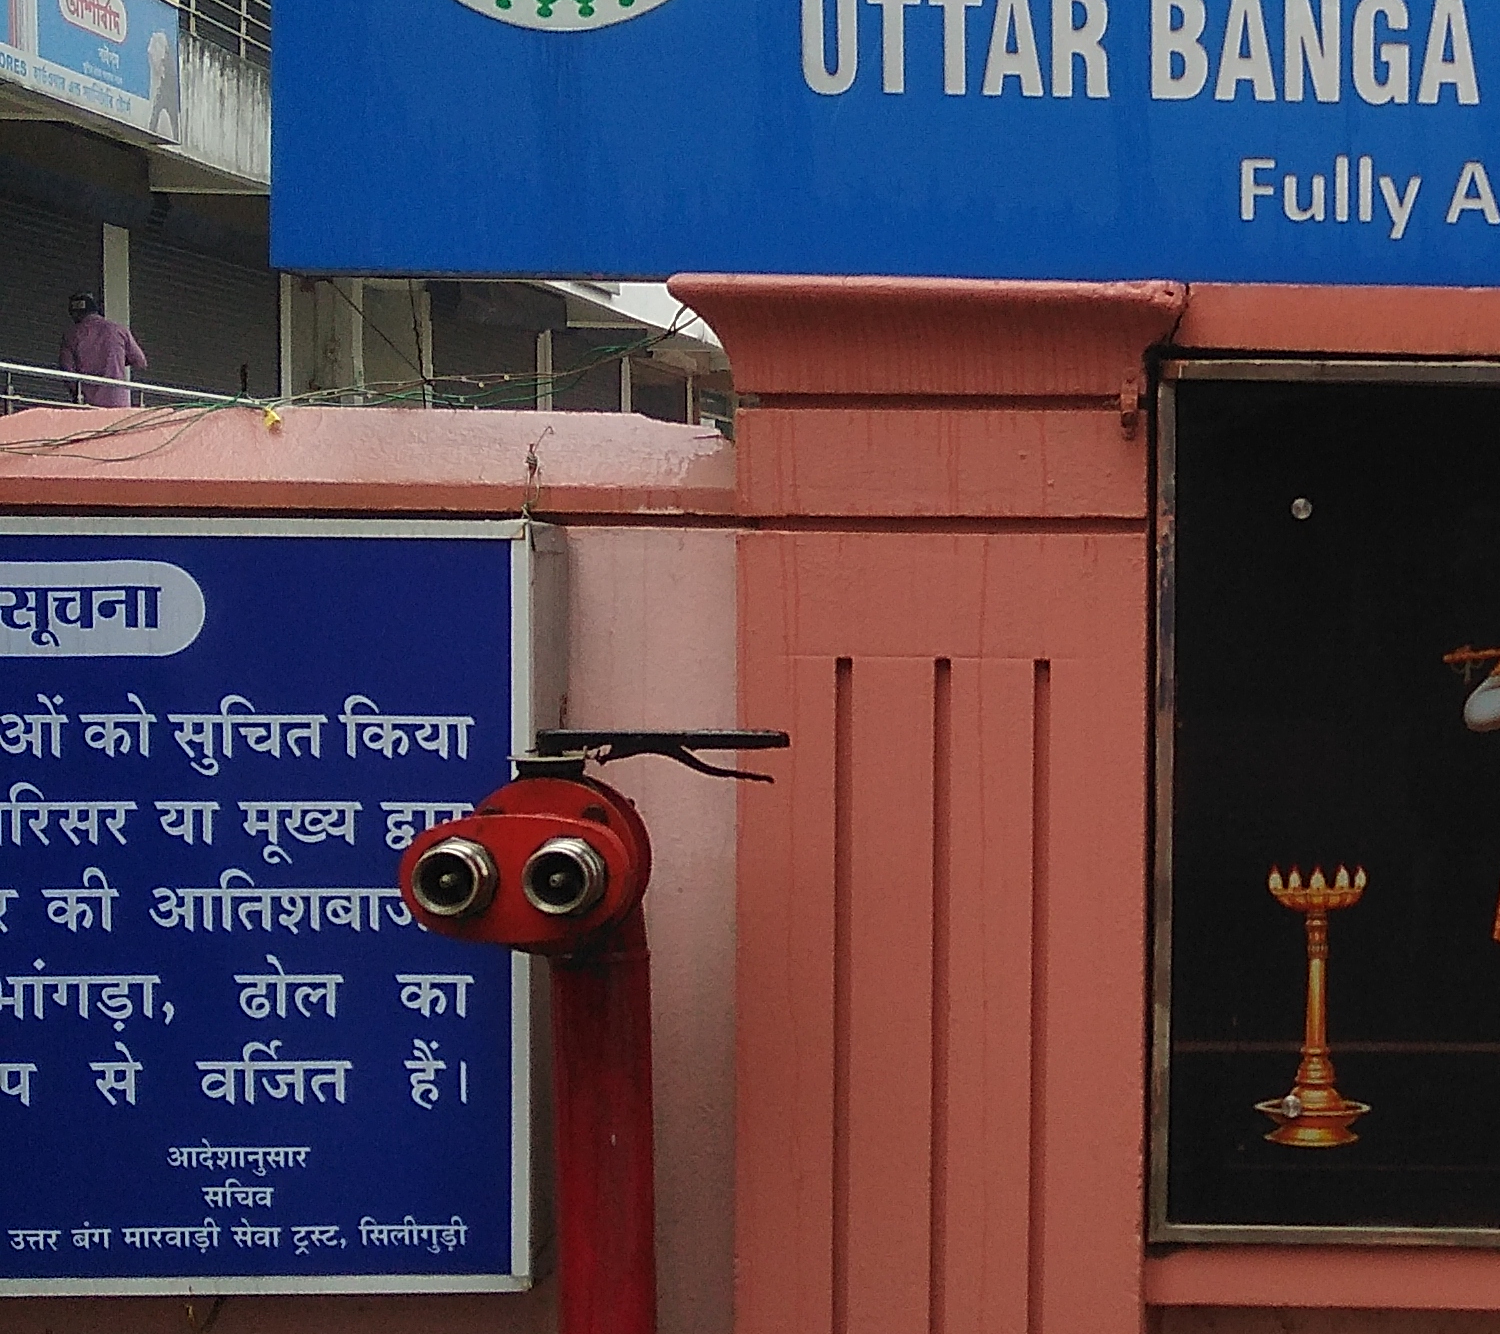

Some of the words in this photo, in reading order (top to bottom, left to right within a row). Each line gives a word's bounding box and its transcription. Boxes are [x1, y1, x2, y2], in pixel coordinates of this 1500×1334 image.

[1239, 155, 1422, 239] Fully
[0, 585, 162, 647] सूचना
[79, 693, 157, 759] को
[168, 695, 328, 775] सुचित
[339, 696, 475, 760] किया
[0, 782, 138, 847] रिसर
[154, 801, 220, 846] या
[42, 867, 119, 933] की
[234, 954, 343, 1019] ढोल
[396, 974, 475, 1019] का
[90, 1040, 143, 1106] से
[196, 1040, 353, 1106] वर्जित
[167, 1138, 311, 1177] आदेशानुसार
[202, 1178, 275, 1208] सचिव
[8, 1229, 62, 1252] उत्तर
[71, 1221, 112, 1250] बंग
[121, 1218, 221, 1255] मारवाड़ी
[231, 1218, 281, 1249] सेवा
[358, 1215, 469, 1255] सिलीगुड़ी
